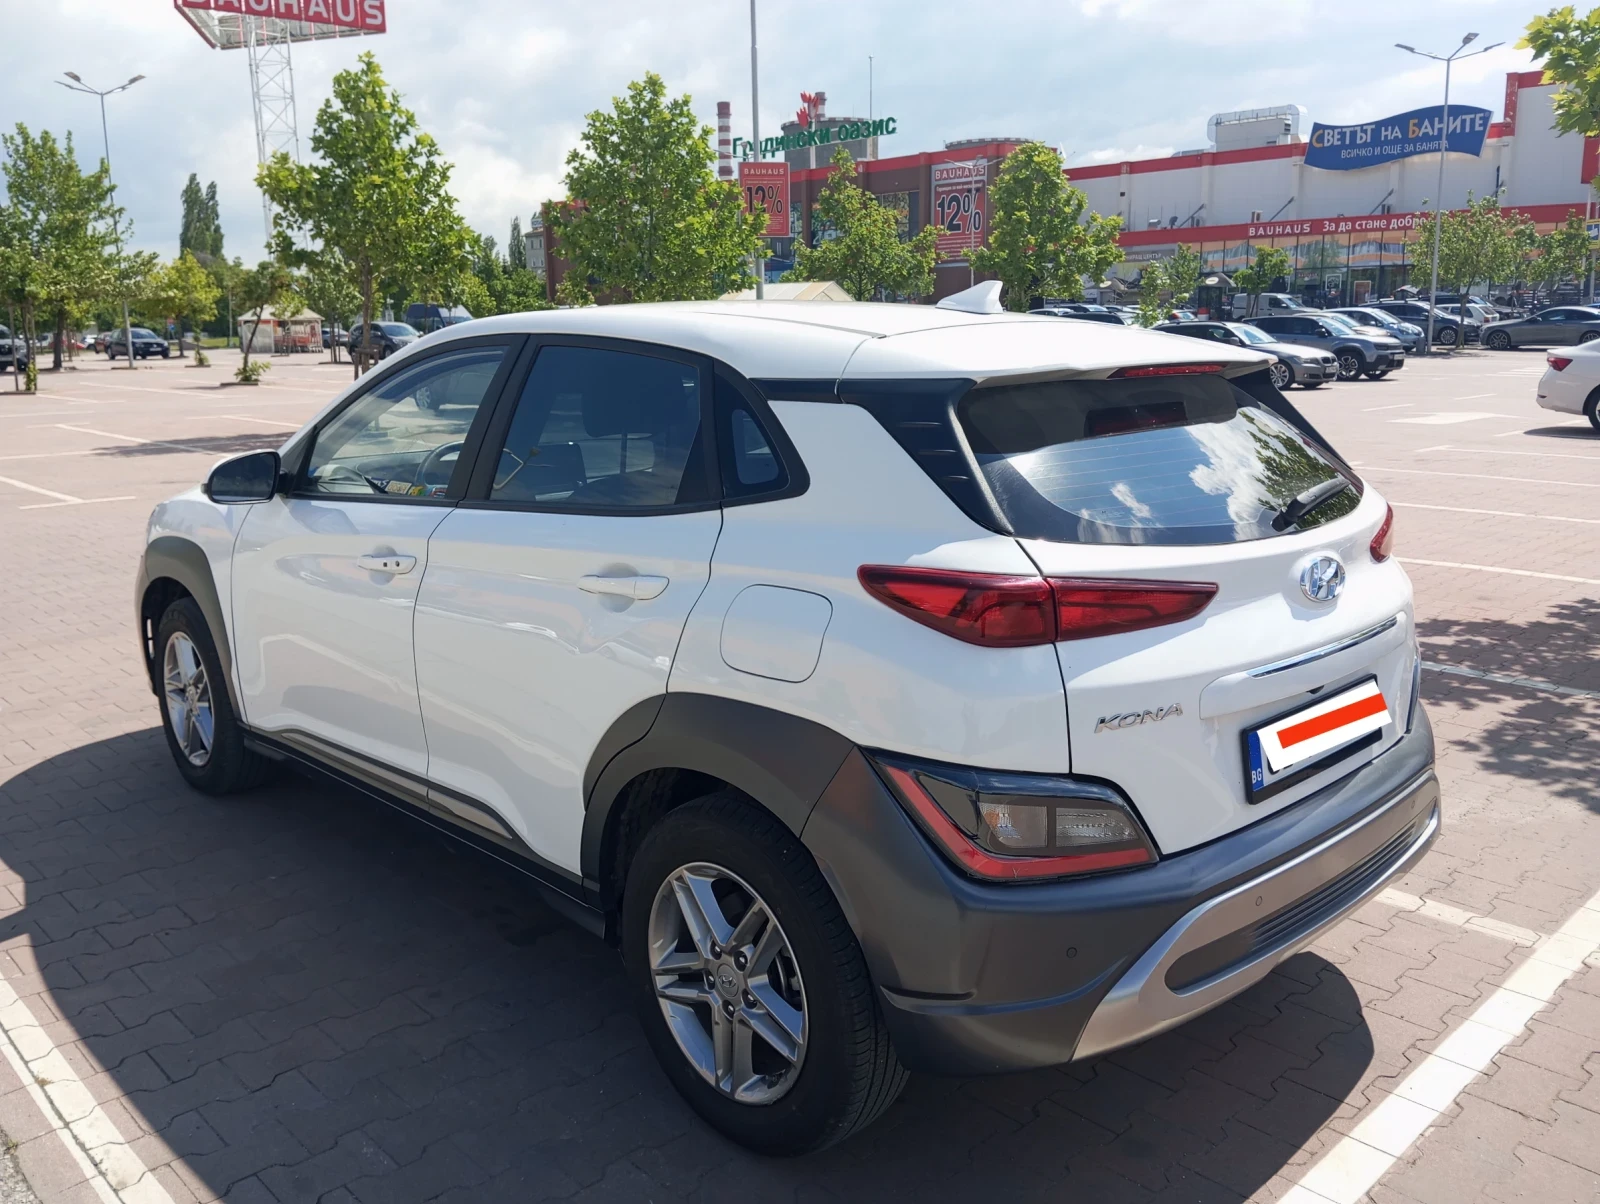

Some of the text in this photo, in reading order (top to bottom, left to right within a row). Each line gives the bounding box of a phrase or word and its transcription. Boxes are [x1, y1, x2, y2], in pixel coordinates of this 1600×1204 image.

[187, 0, 383, 25] HAUS
[733, 117, 897, 161] Грдински оазис
[1312, 113, 1484, 148] СВЕТЪТ НА БАНИТЕ
[1341, 147, 1373, 159] ВСИЧКО
[1375, 146, 1381, 156] И
[1382, 144, 1403, 155] ОЩЕ
[1404, 143, 1414, 153] ЗА
[935, 165, 985, 180] BAUHAUS
[746, 185, 783, 214] 12%
[936, 192, 982, 234] 12%
[1322, 221, 1336, 232] За
[1338, 221, 1352, 232] да
[1355, 219, 1387, 230] стане
[1249, 223, 1311, 237] BAUHAUS
[1094, 703, 1183, 734] KONA
[1251, 768, 1262, 784] BG
